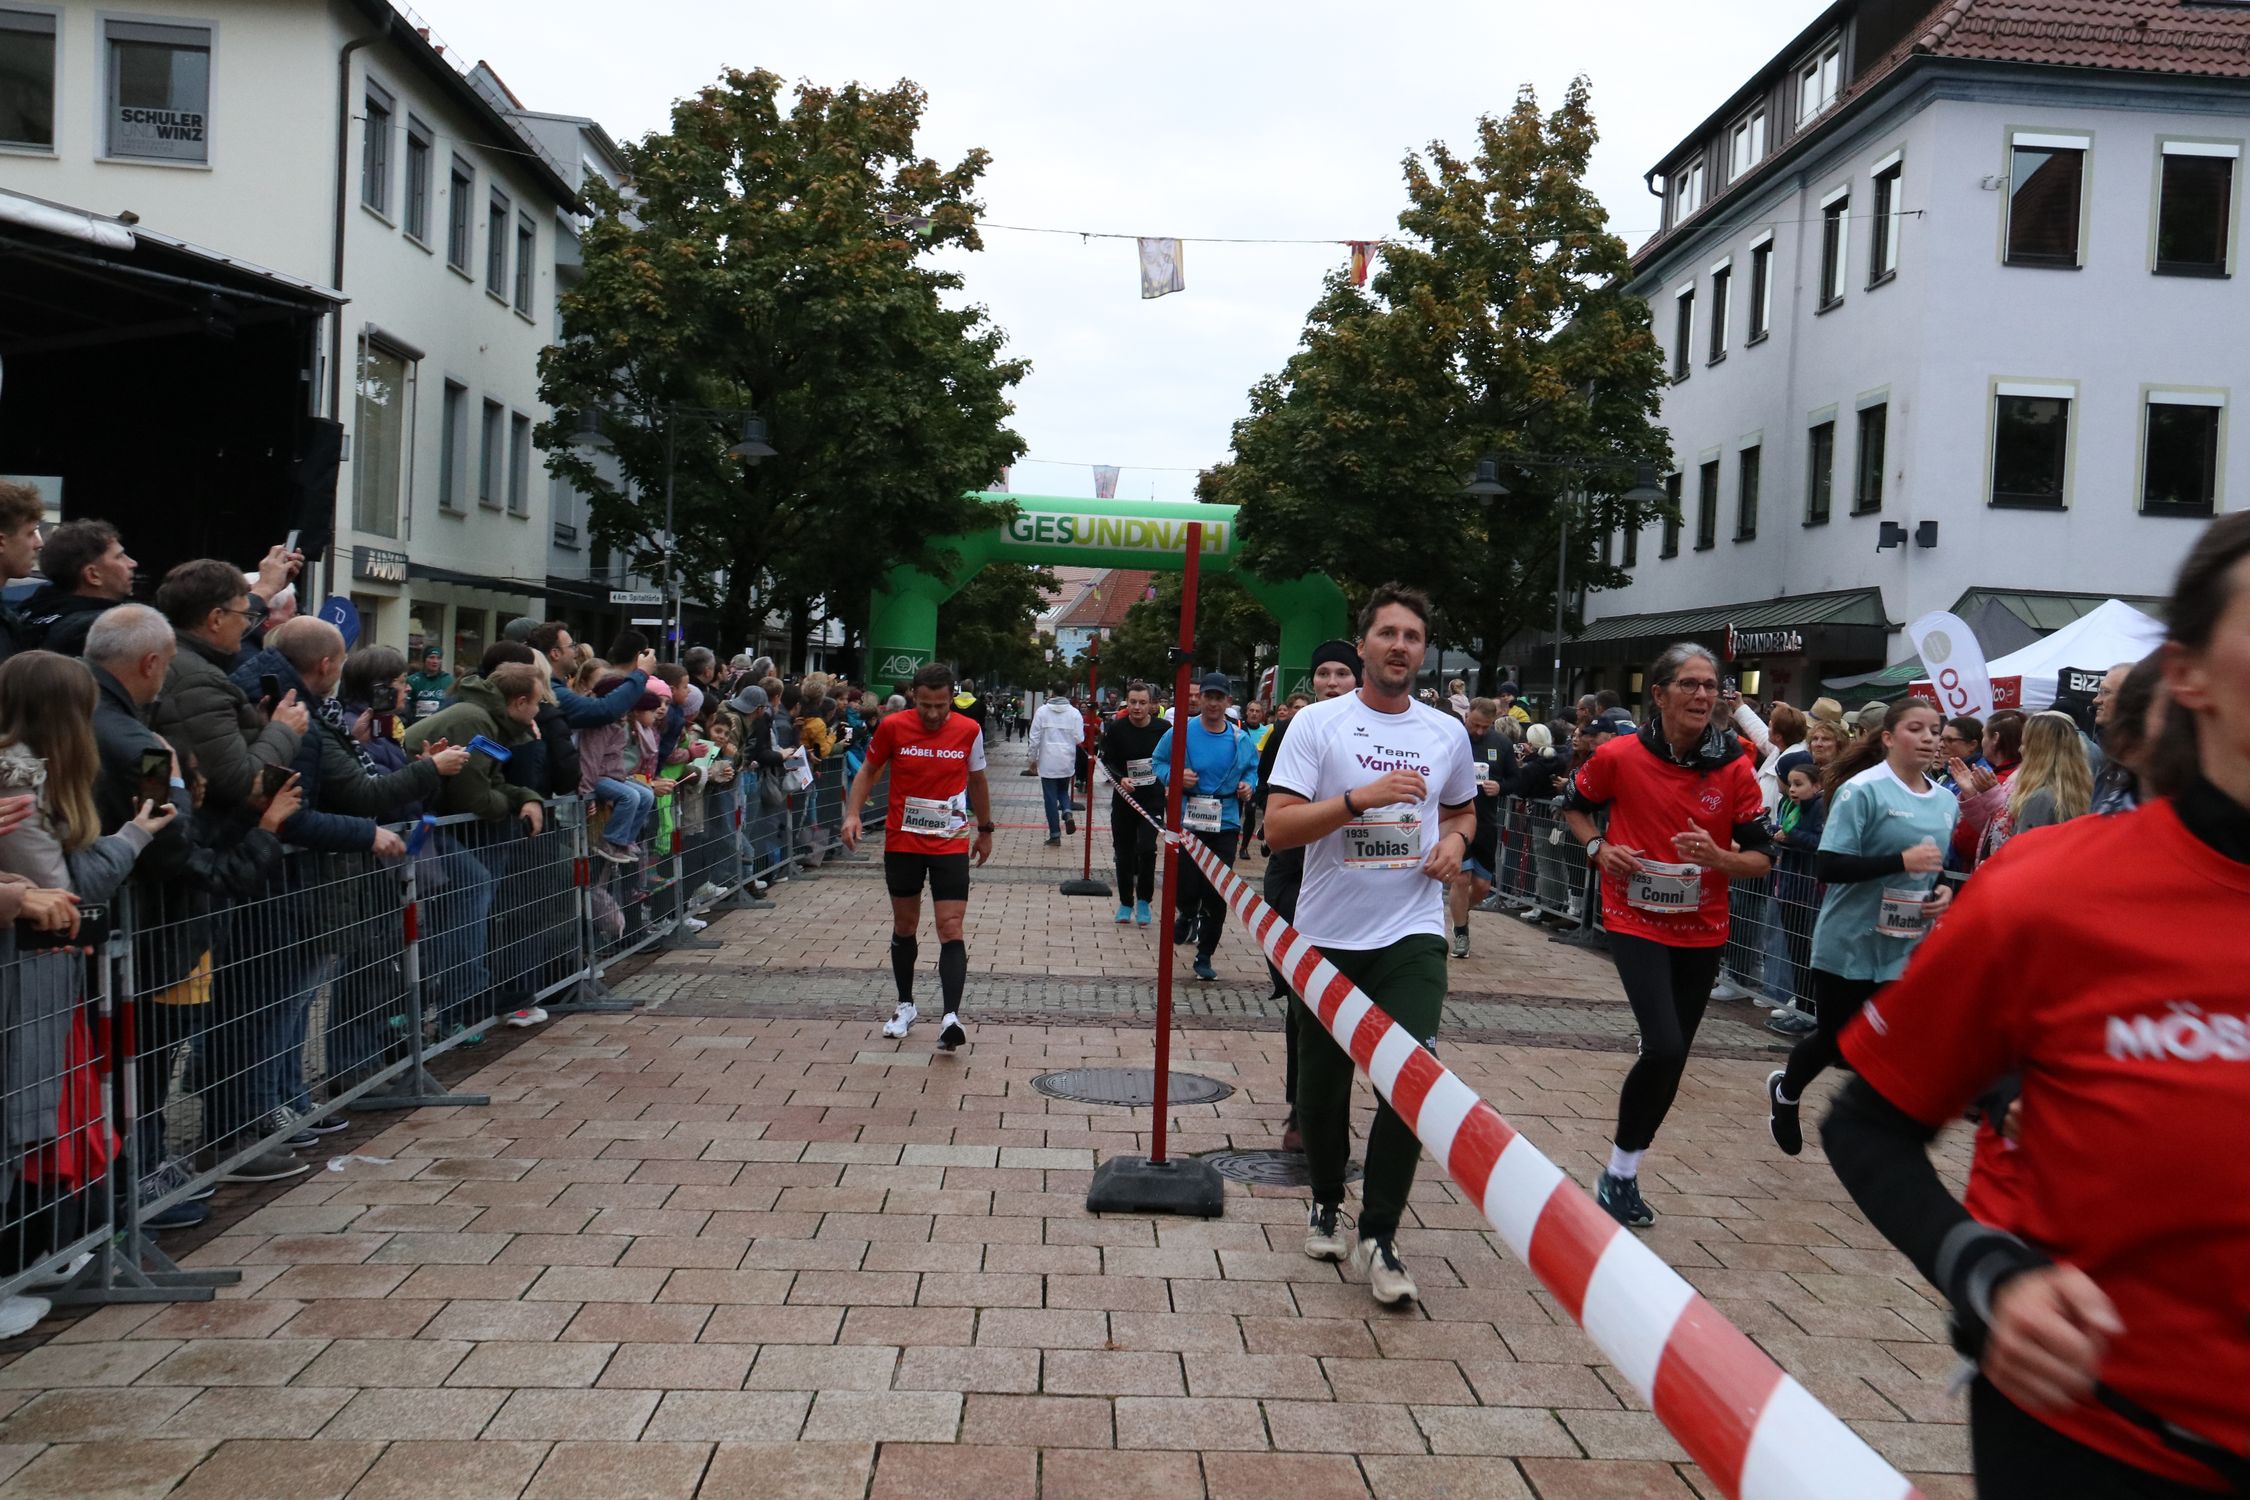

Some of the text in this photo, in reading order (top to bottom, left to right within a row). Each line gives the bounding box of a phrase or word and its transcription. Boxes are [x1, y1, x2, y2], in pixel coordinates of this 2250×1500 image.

[121, 108, 203, 128] SCHULER
[880, 655, 924, 675] AOK
[900, 746, 964, 759] MÖBEL ROGG
[1373, 745, 1420, 758] Team
[1356, 754, 1431, 776] Vantive
[905, 815, 946, 829] Andreas
[1345, 829, 1369, 838] 1935
[1354, 840, 1409, 857] Tobias
[1631, 874, 1652, 885] 1253
[1641, 887, 1684, 903] Conni
